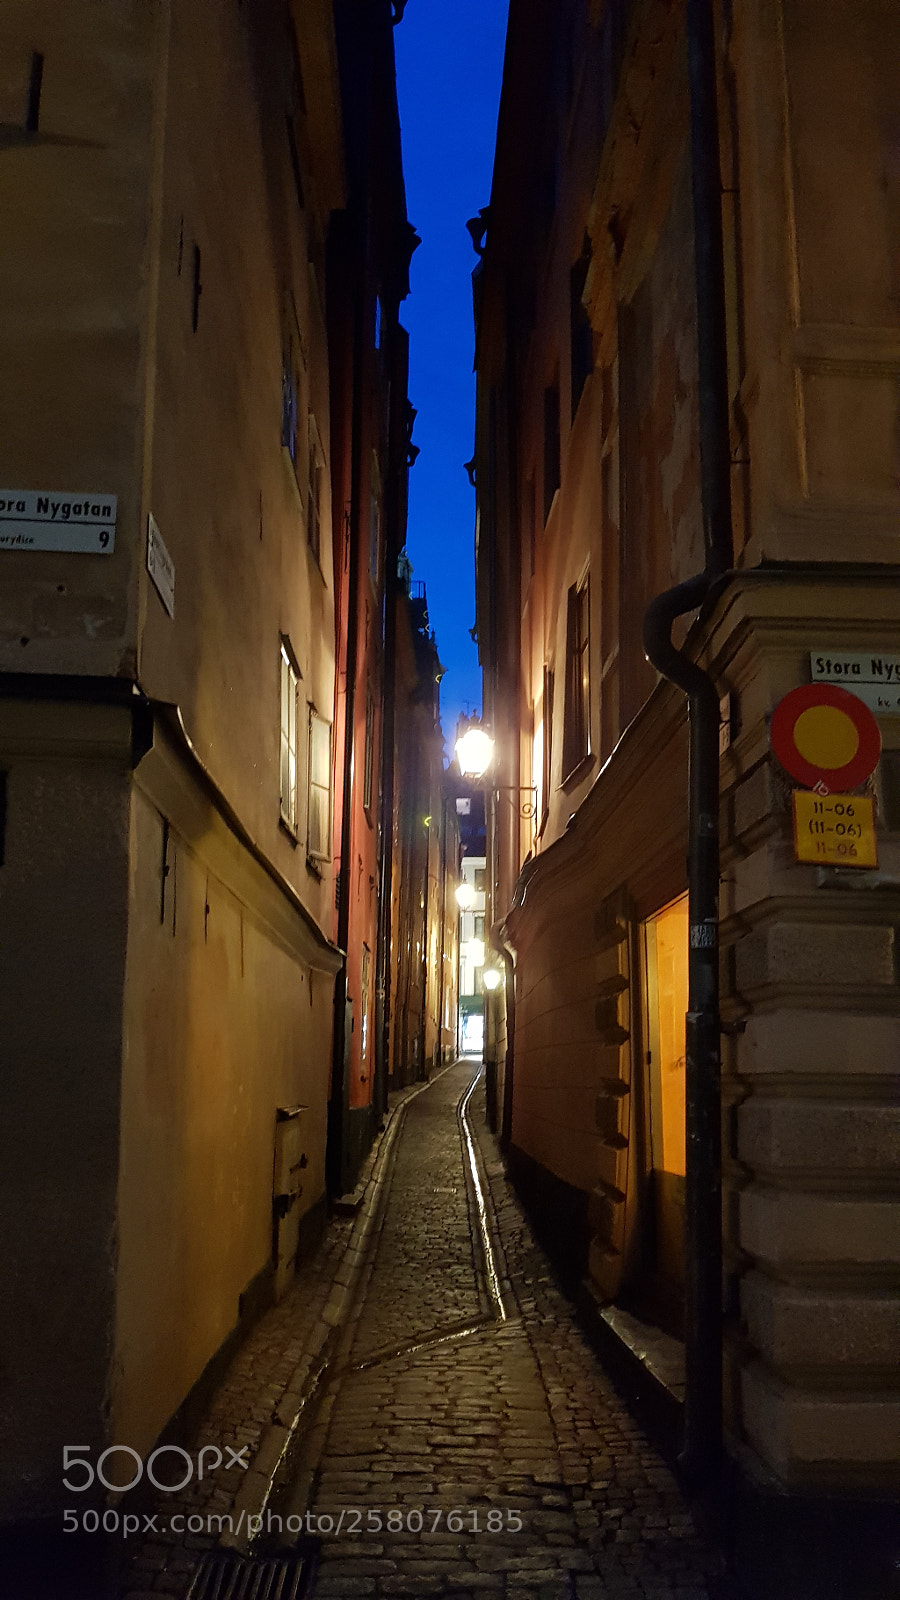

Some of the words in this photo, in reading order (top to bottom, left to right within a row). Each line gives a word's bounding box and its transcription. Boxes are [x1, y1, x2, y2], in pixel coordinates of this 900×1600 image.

[37, 497, 111, 519] Nygatan
[99, 531, 109, 548] 9
[816, 657, 860, 674] Stora
[813, 801, 855, 816] 11-06
[809, 818, 862, 838] (11-06)
[816, 841, 858, 857] 11-06
